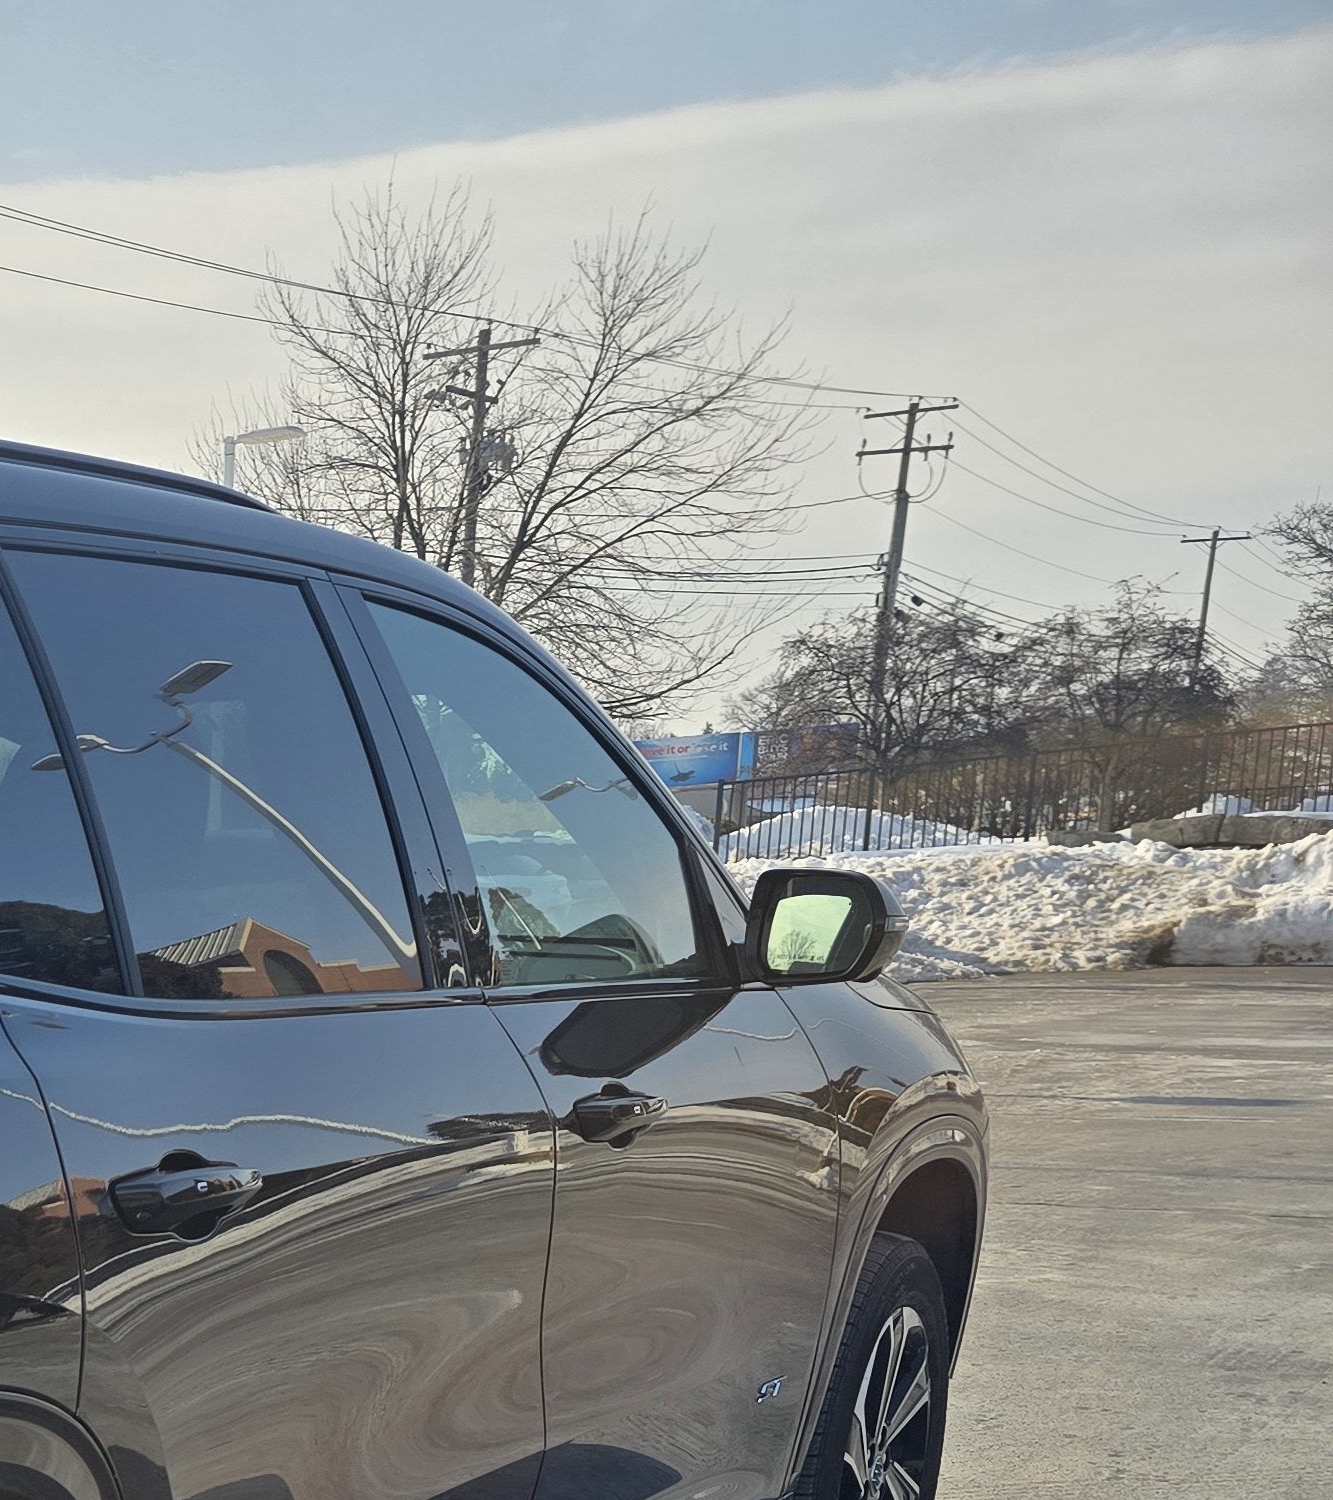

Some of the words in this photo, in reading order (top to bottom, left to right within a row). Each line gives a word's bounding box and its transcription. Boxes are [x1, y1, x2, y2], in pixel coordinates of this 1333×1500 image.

[666, 745, 675, 755] it
[677, 745, 690, 754] or
[719, 742, 728, 751] it
